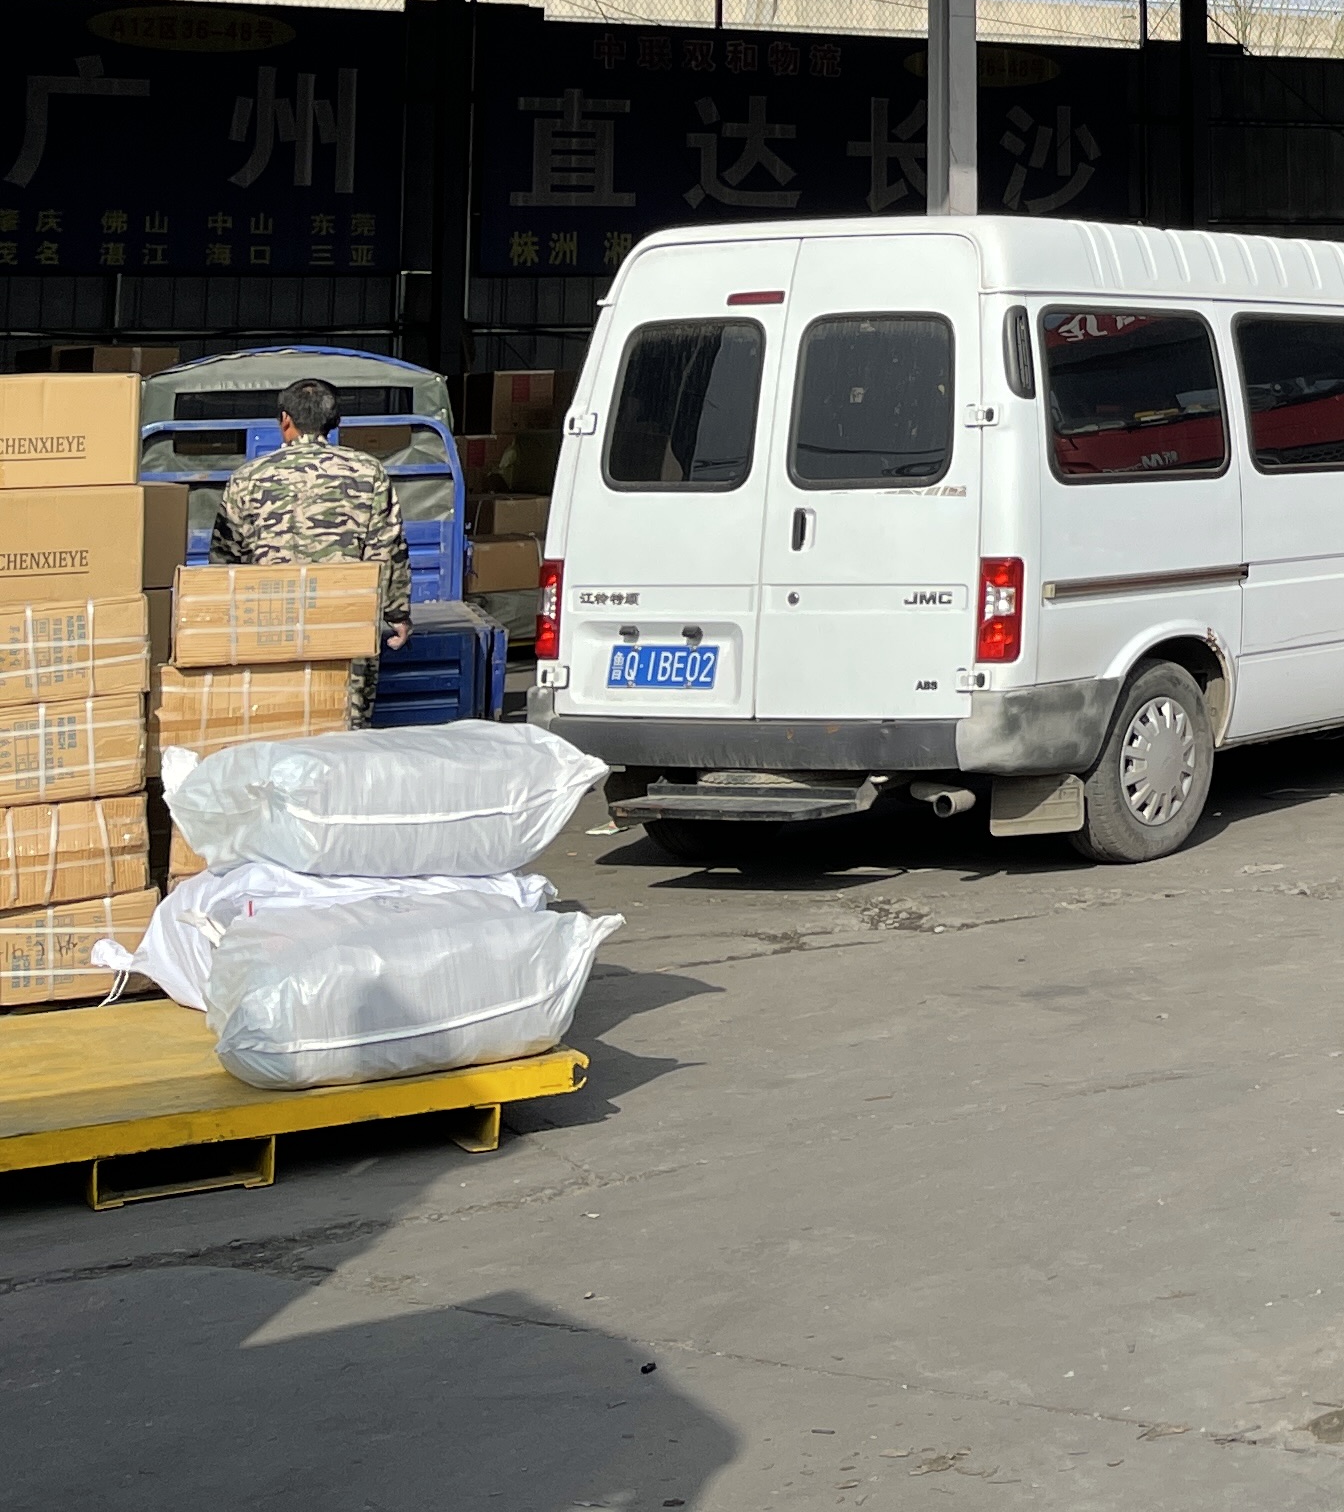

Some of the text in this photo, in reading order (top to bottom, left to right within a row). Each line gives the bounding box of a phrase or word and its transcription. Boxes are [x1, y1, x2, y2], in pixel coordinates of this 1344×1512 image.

[592, 31, 843, 79] 中联双和物流
[100, 209, 170, 235] 佛山
[206, 211, 274, 237] 中山
[309, 212, 377, 237] 东莞
[205, 242, 273, 267] 海口
[308, 243, 377, 267] 三亚
[903, 591, 954, 605] JMC
[915, 680, 938, 691] ABS
